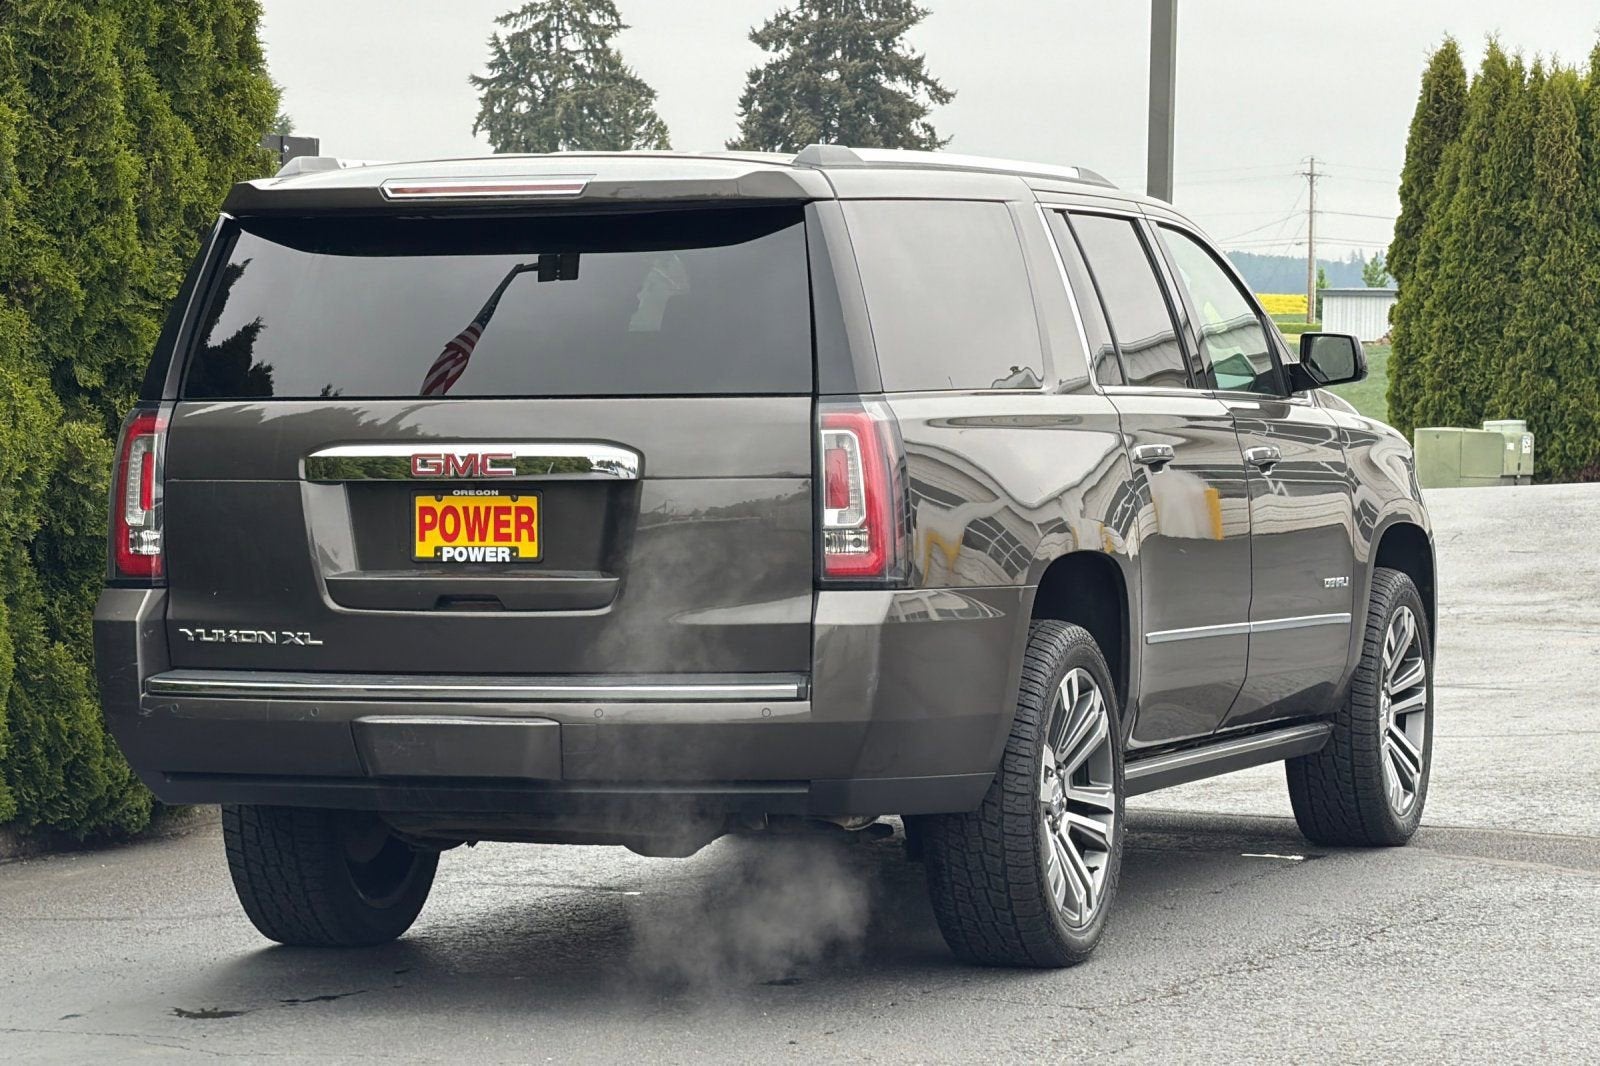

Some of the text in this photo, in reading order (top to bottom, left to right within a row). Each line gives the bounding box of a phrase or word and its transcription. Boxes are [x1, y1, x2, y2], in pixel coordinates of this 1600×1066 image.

[411, 452, 517, 477] GMC
[418, 504, 536, 543] POWER
[441, 546, 511, 563] POWER
[178, 628, 324, 646] YUKON XL
